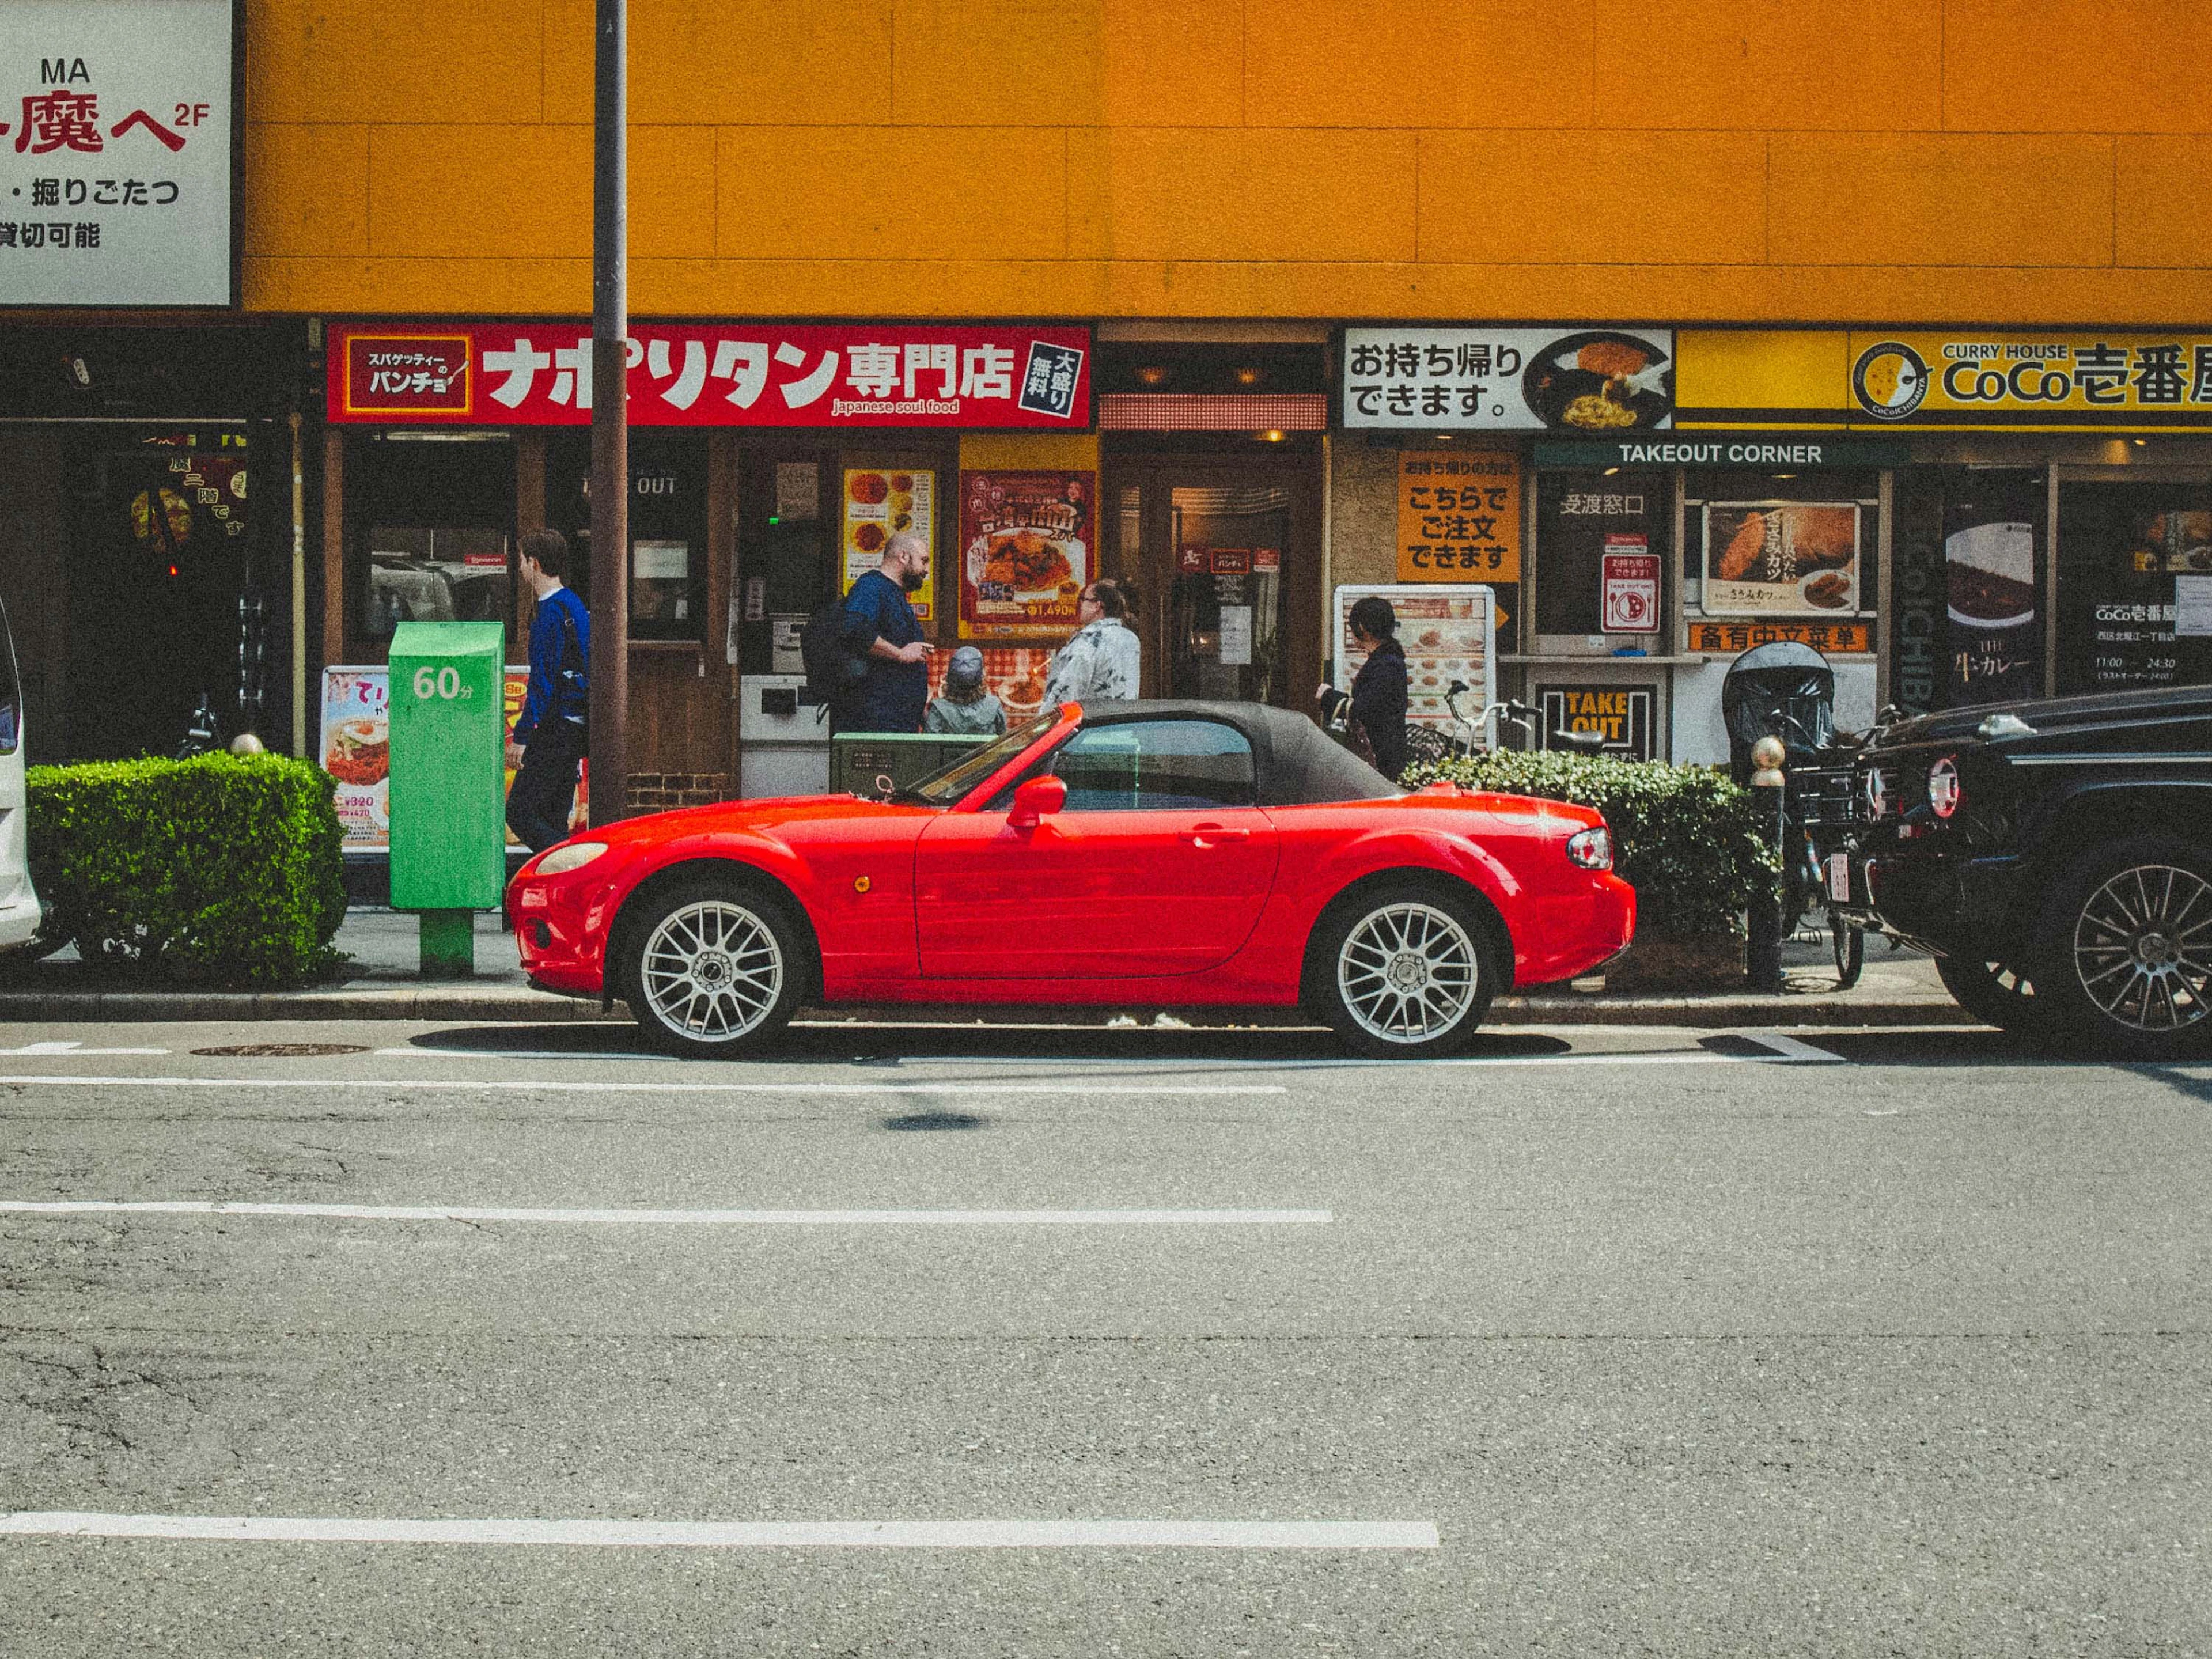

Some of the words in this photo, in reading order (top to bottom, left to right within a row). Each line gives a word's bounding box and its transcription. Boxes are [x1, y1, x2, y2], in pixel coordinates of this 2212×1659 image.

[41, 58, 90, 84] MA
[0, 90, 186, 154] 魔へ
[175, 104, 210, 126] 2F
[0, 222, 100, 248] 貸切可能
[1350, 343, 1521, 378] お持ち帰り
[1943, 345, 1999, 359] CURRY
[2005, 345, 2068, 359] HOUSE
[370, 372, 447, 393] パンチョ
[483, 338, 1014, 411] ナポリタン専門店
[1027, 356, 1051, 398] 無料
[1051, 351, 1077, 410] 大盛り
[833, 400, 894, 414] japanese
[897, 399, 925, 413] soul
[927, 399, 959, 413] food
[1350, 384, 1505, 418] できます。
[1619, 444, 1722, 462] TAKEOUT
[1729, 445, 1822, 463] CORNER
[637, 477, 677, 494] OUT
[1410, 486, 1508, 511] こちらで
[1560, 494, 1644, 515] 受渡窓口
[1421, 515, 1497, 541] ご注文
[1407, 545, 1508, 569] できます
[413, 666, 474, 700] 60分
[1566, 691, 1628, 715] TAKE
[1571, 717, 1623, 740] OUT
